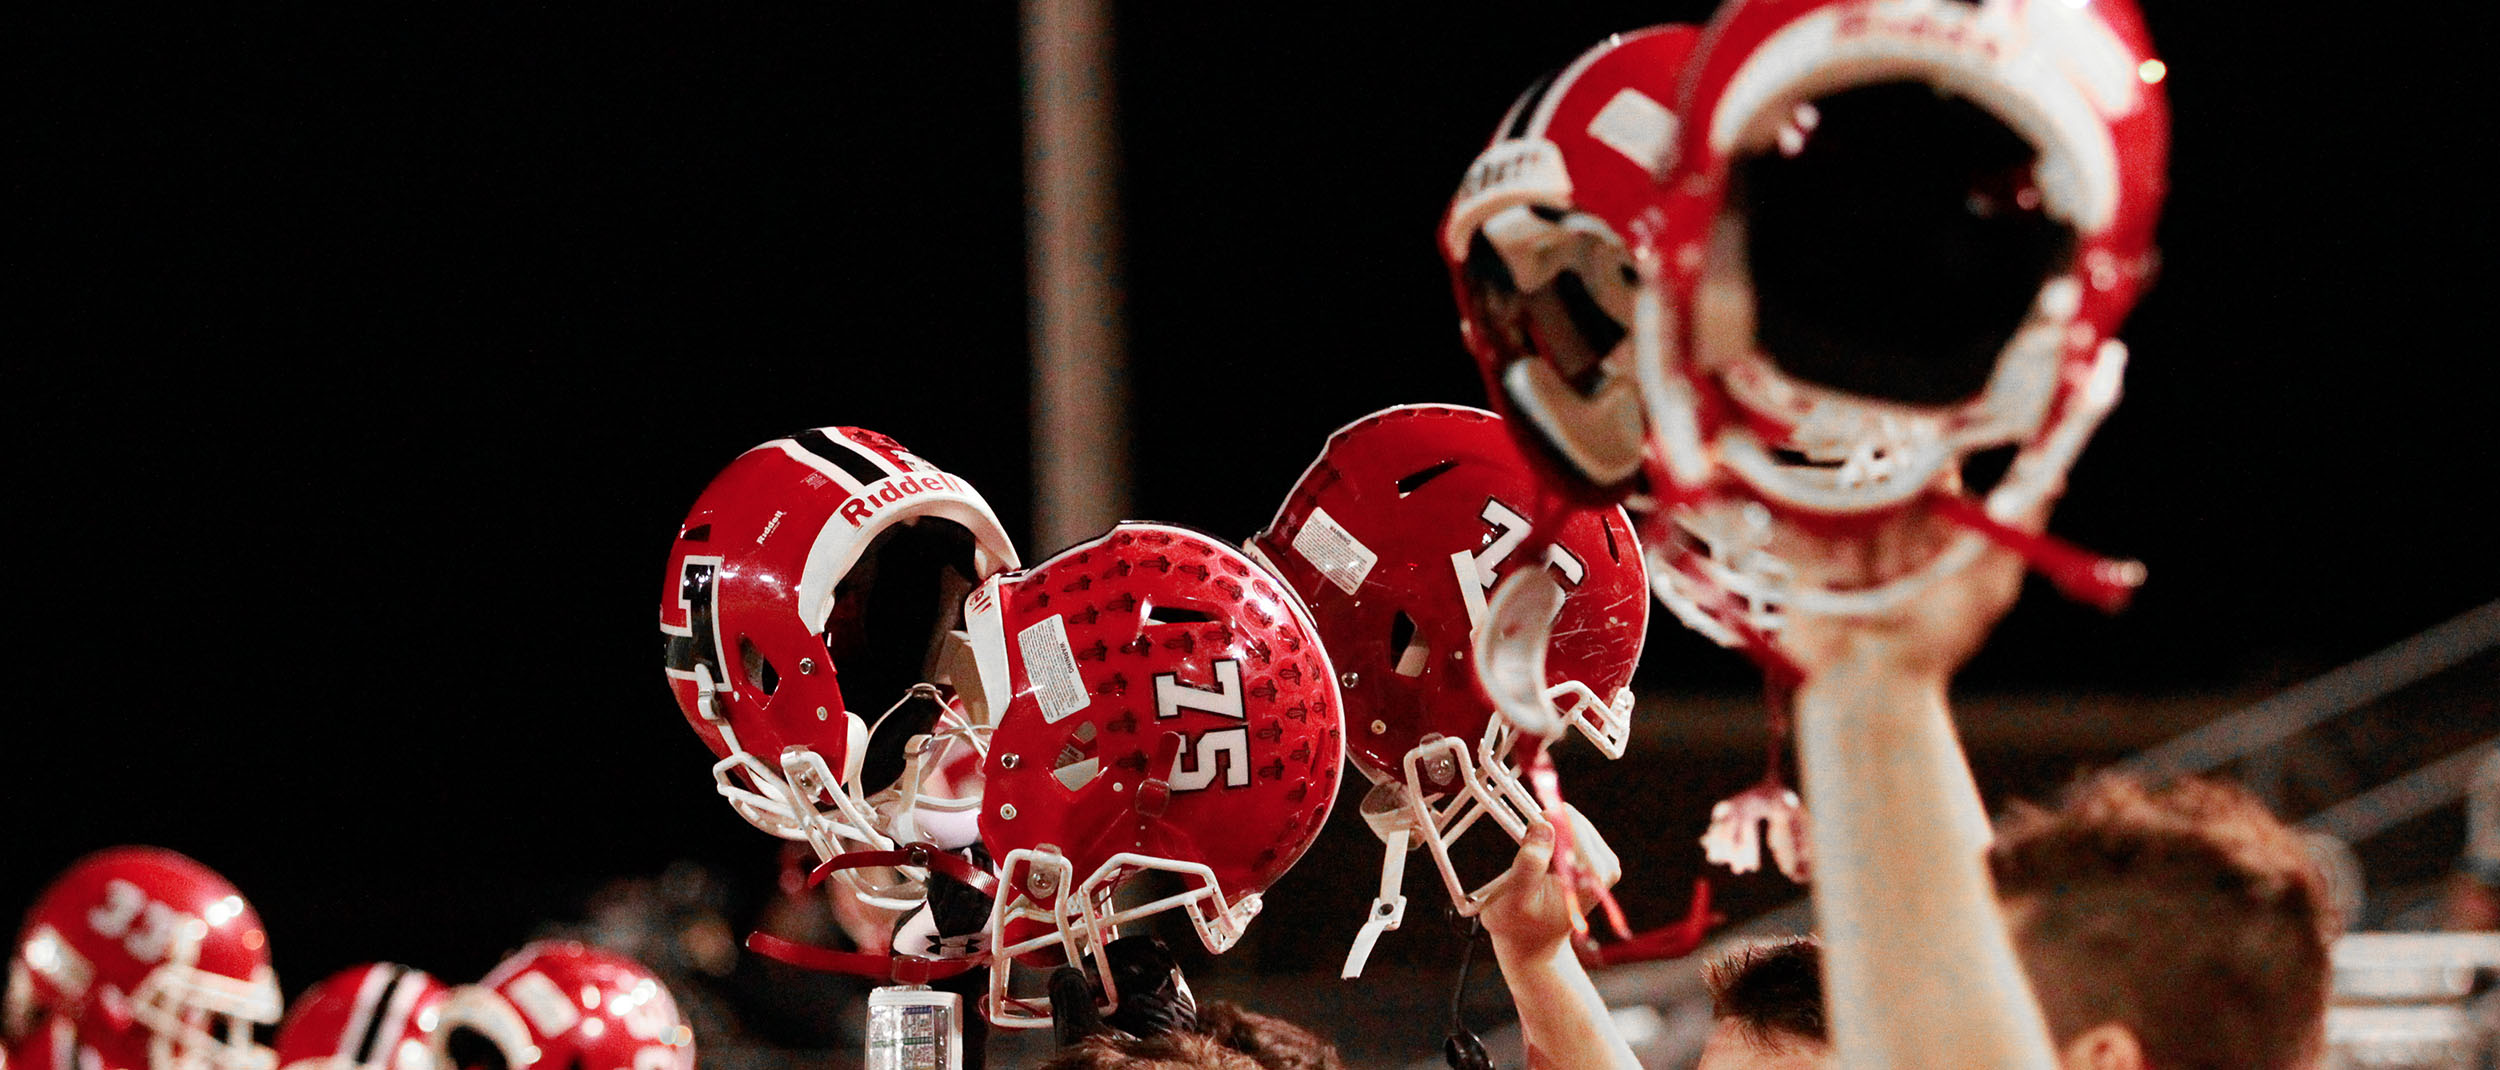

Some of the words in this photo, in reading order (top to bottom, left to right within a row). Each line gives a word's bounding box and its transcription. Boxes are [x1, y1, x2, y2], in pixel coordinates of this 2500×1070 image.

[840, 472, 964, 528] Riddell
[756, 510, 783, 545] Riddell
[1060, 642, 1074, 673] WARNING
[1154, 659, 1251, 792] 75
